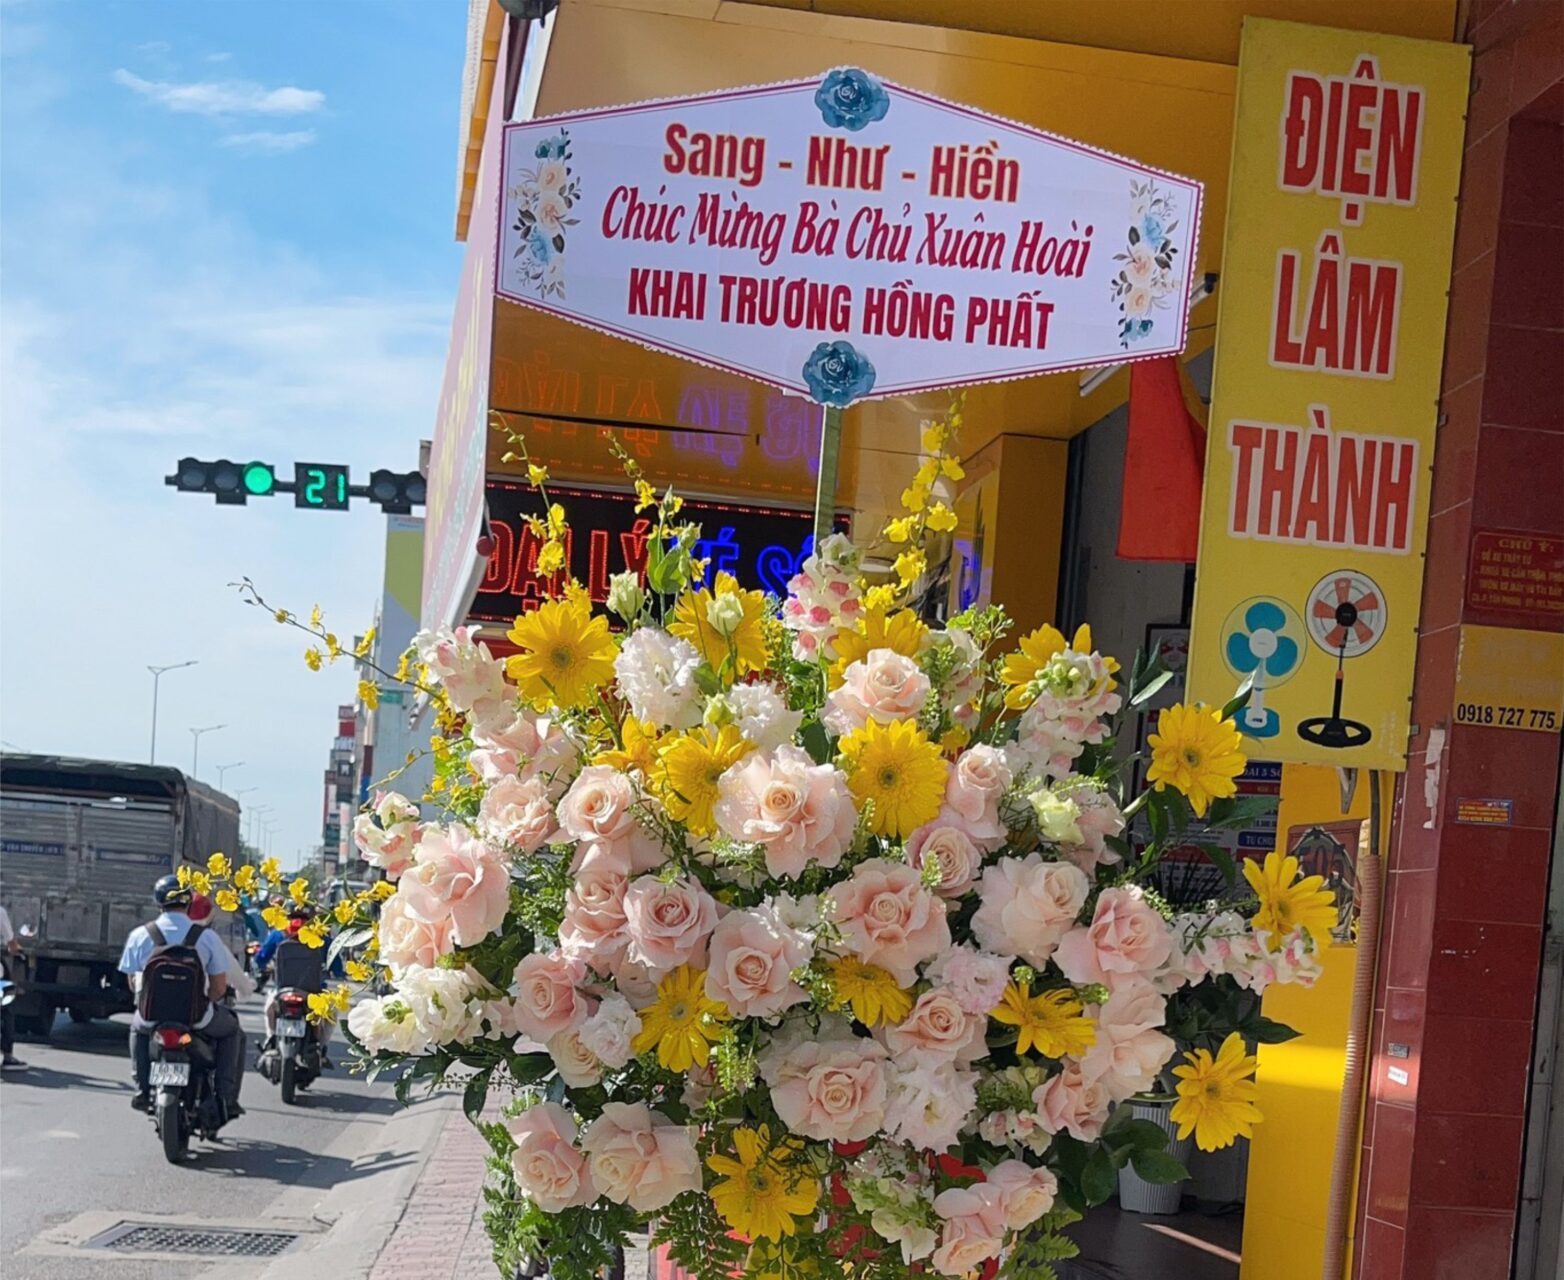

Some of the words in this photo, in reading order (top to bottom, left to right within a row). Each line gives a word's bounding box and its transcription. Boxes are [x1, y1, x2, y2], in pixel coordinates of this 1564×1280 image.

[663, 122, 767, 188] Sang
[806, 135, 891, 192] Như
[929, 139, 1020, 203] Hiền
[1281, 57, 1423, 222] ĐIỆN
[602, 184, 685, 243] Chúc
[688, 190, 787, 266] Mừng
[791, 199, 840, 257] Bà
[846, 202, 912, 263] Chủ
[915, 212, 1006, 271] Xuân
[1011, 219, 1094, 278] Hoài
[627, 267, 708, 321] KHAI
[719, 274, 852, 333] TRƯƠNG
[862, 278, 955, 342] HỒNG
[965, 290, 1055, 350] PHẤT
[1271, 233, 1399, 376] LÂM
[305, 469, 345, 503] 21
[1230, 408, 1416, 551] THÀNH
[1457, 703, 1493, 724] 0918
[1498, 706, 1525, 727] 727
[1530, 709, 1556, 729] 775
